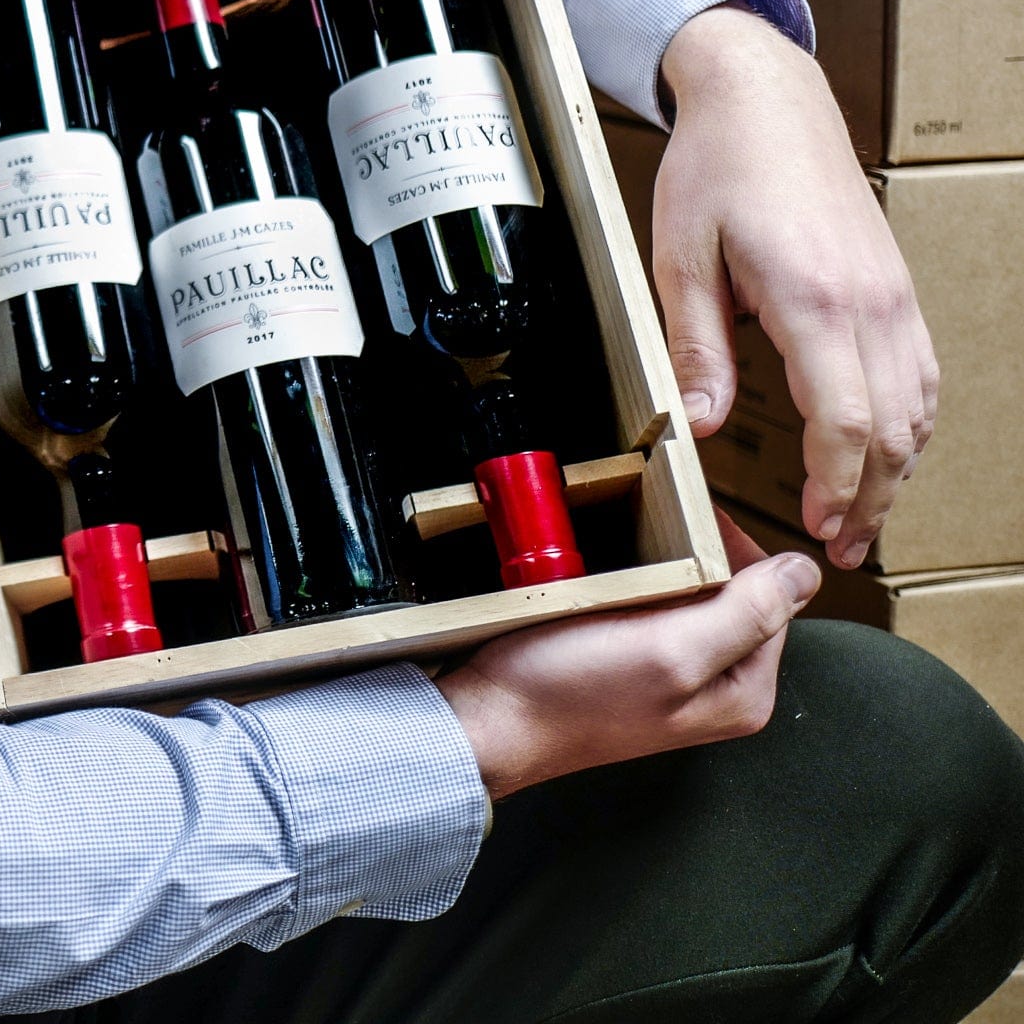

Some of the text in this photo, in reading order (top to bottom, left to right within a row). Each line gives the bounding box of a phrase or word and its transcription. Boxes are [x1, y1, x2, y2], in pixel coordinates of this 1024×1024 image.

[404, 78, 432, 89] 2017
[356, 125, 515, 180] PAUILLAC
[454, 172, 505, 186] FAMILLE
[387, 185, 426, 207] CAZES
[179, 232, 227, 258] FAMILLE
[255, 221, 294, 234] CAZES
[47, 250, 97, 264] FAMILLE
[170, 256, 329, 316] PAUILLAC
[231, 288, 279, 304] PAUILLAC
[247, 332, 275, 344] 2017
